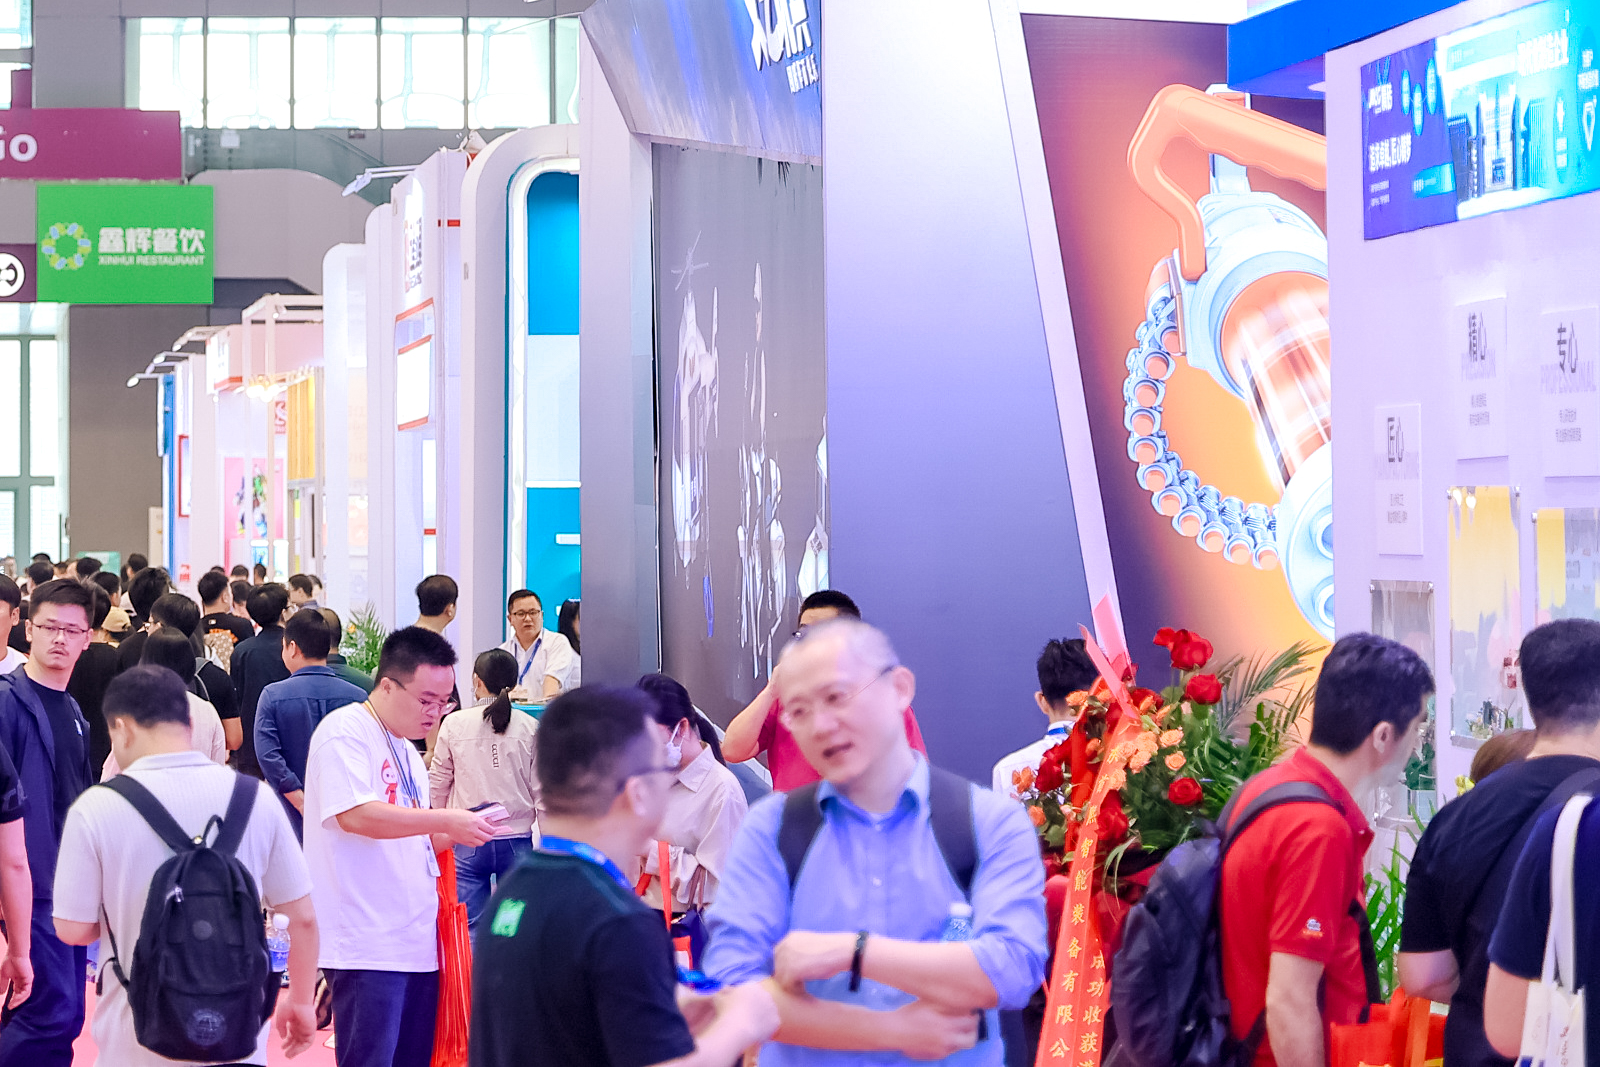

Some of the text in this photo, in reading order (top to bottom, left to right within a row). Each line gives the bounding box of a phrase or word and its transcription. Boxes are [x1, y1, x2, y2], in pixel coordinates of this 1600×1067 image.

[98, 227, 206, 254] 鑫辉餐饮
[136, 255, 205, 266] RESTAURANT
